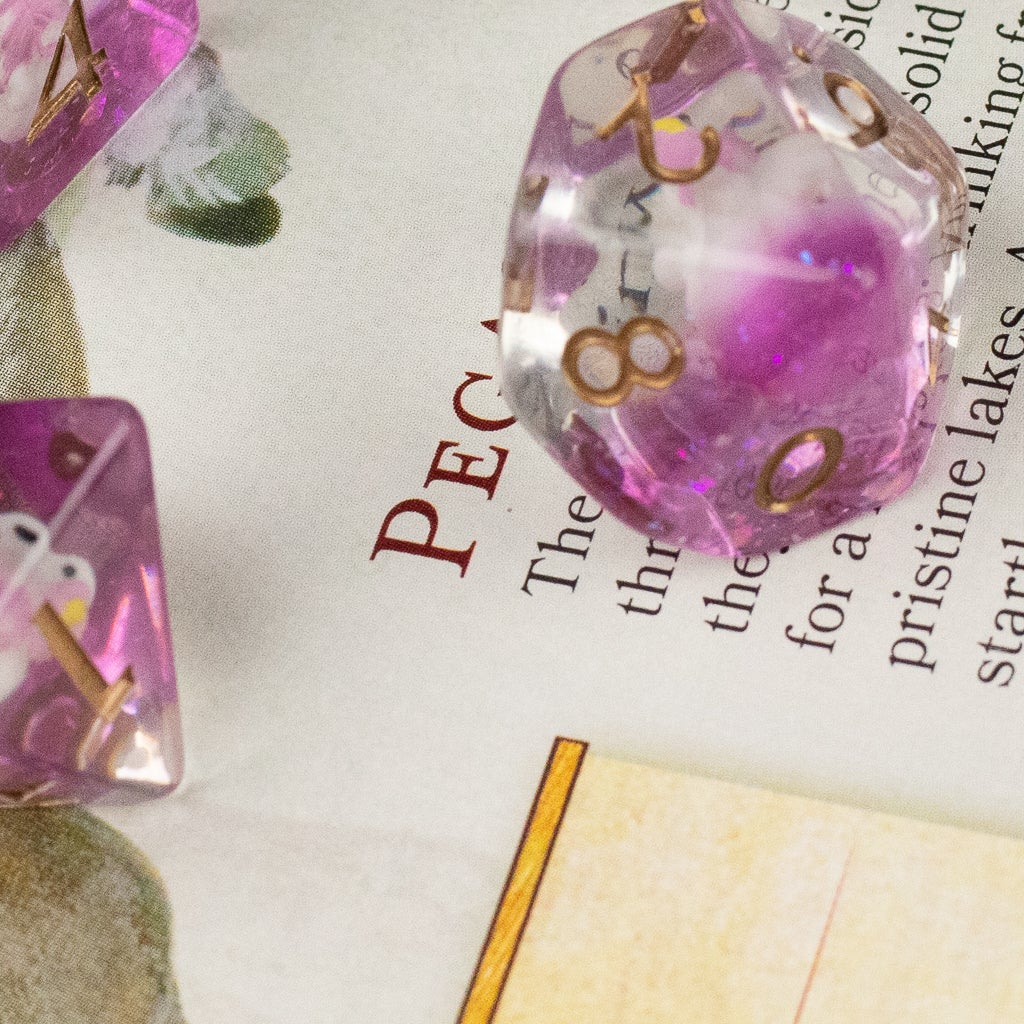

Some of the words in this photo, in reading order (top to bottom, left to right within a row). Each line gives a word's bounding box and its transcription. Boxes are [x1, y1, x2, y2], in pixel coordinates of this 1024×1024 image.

[562, 316, 685, 407] 8
[520, 495, 604, 597] The
[785, 574, 854, 655] for
[832, 532, 872, 561] a
[888, 459, 986, 674] pristine
